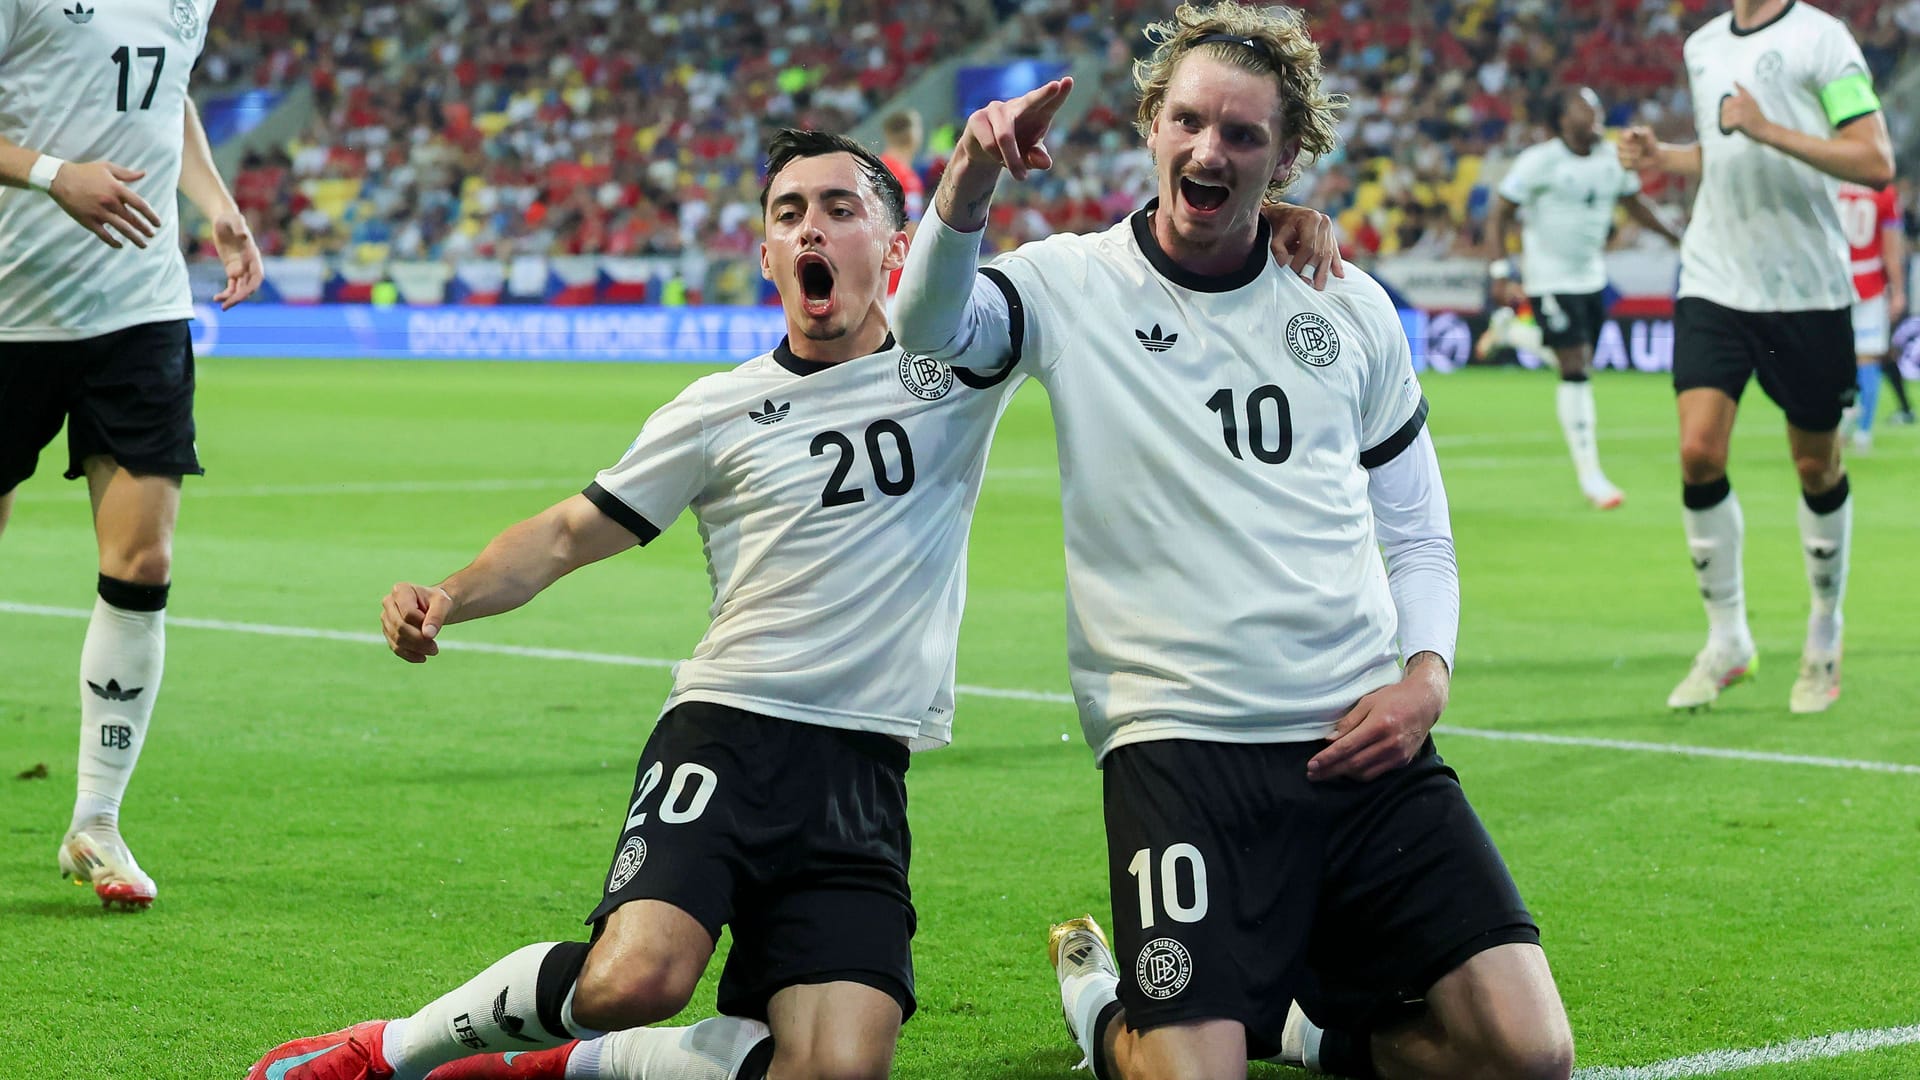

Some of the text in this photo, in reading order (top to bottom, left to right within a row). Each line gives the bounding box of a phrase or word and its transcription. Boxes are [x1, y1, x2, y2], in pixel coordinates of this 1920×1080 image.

[111, 46, 166, 112] 17
[407, 313, 788, 356] DISCOVER MORE AT BY
[1206, 384, 1293, 465] 10
[808, 418, 916, 508] 20
[624, 760, 718, 834] 20
[1127, 842, 1208, 930] 10
[1138, 947, 1154, 994] DEUTSCHER
[1153, 940, 1188, 964] FUSSBALL
